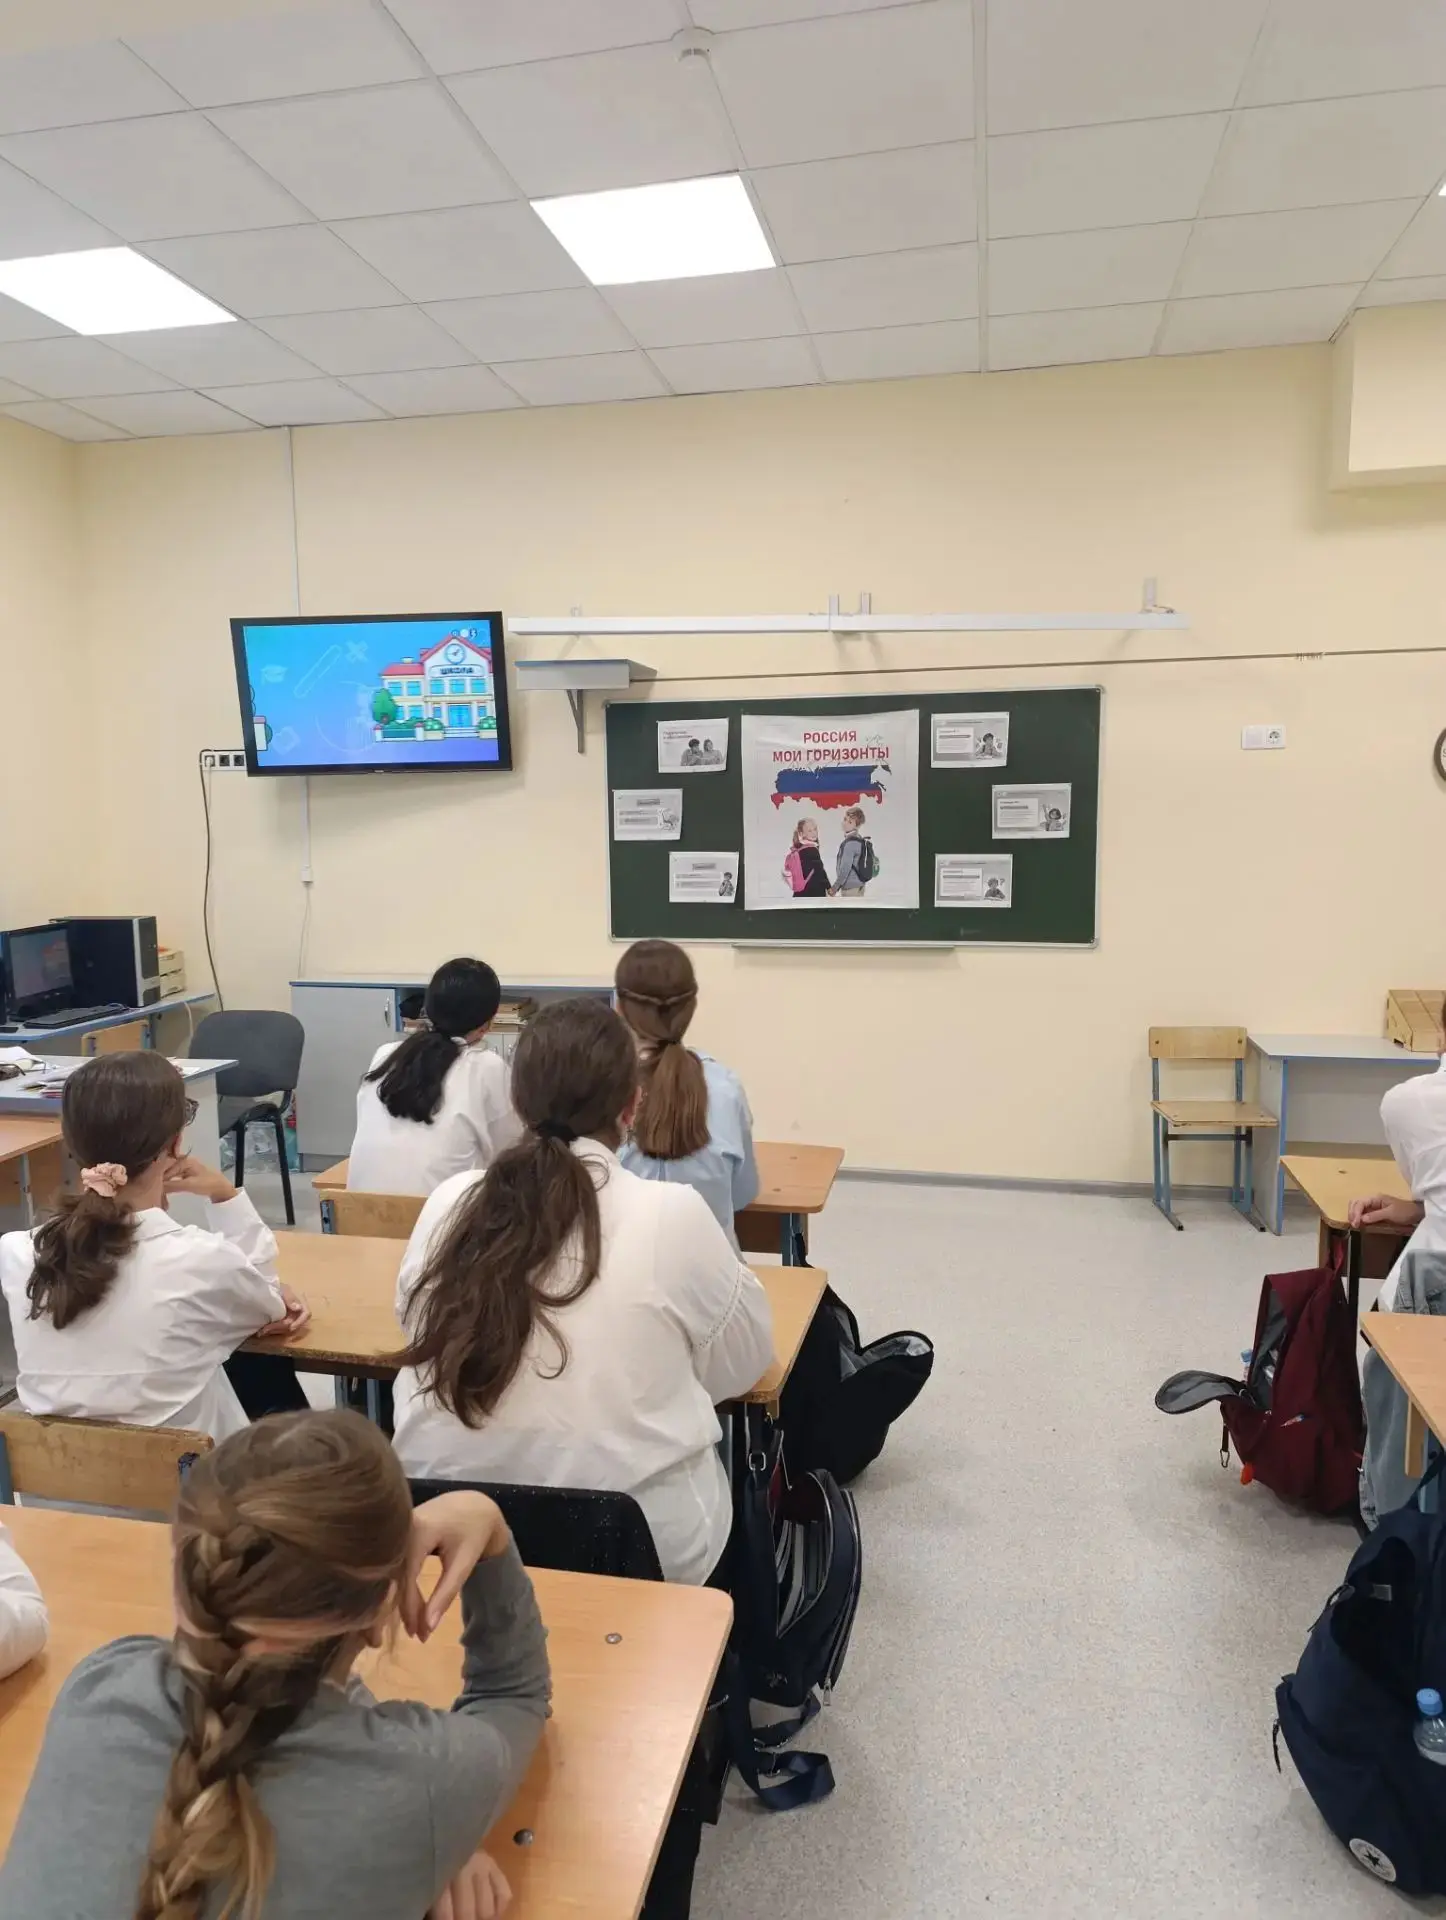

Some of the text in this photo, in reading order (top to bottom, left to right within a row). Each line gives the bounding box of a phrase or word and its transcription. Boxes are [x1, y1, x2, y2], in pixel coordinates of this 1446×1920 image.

[803, 731, 857, 743] РОССИЯ
[773, 747, 889, 762] МОИ ГОРИЗОНТЫ
